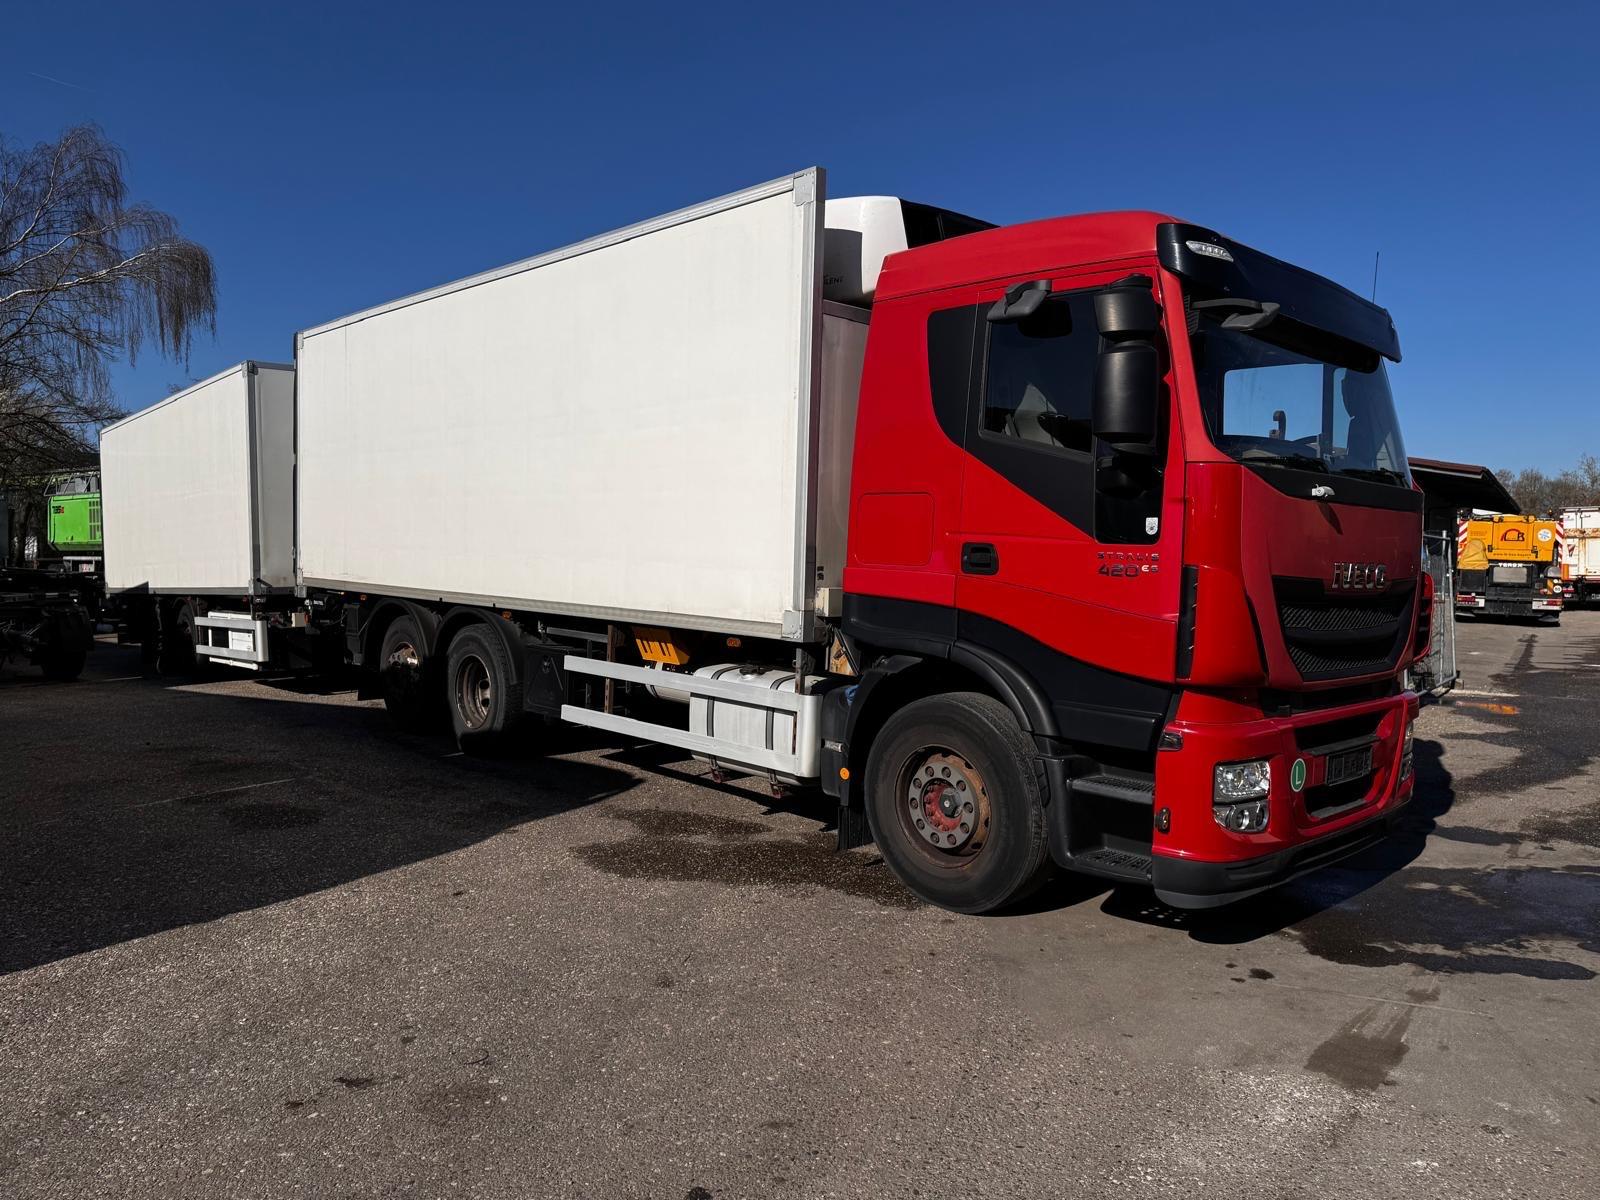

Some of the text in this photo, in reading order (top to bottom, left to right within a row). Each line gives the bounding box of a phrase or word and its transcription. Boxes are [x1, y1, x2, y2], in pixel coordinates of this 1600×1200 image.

[1097, 552, 1160, 561] STRALIS
[1098, 563, 1140, 577] 420
[1332, 562, 1386, 589] IVECO
[1295, 765, 1302, 785] L
